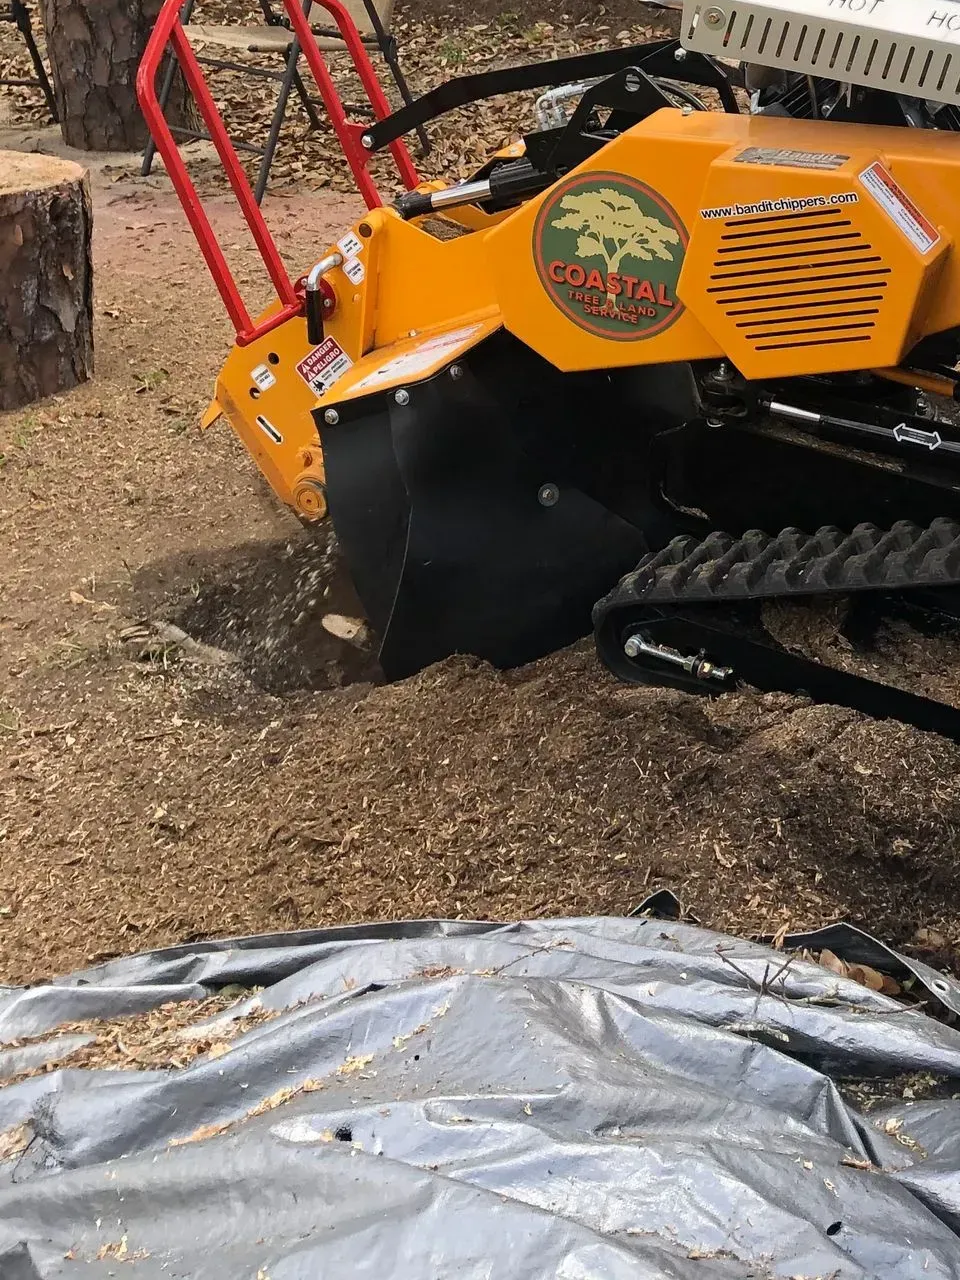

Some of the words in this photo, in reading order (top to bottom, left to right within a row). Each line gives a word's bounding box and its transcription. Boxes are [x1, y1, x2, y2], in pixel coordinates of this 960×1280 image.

[701, 192, 858, 219] www.banditchippers.com
[549, 260, 674, 307] COASTAL
[568, 290, 600, 305] TREE
[619, 304, 656, 318] LAND
[584, 304, 639, 324] SERVICE
[306, 340, 334, 366] DANGER
[313, 348, 341, 374] PELIGRO
